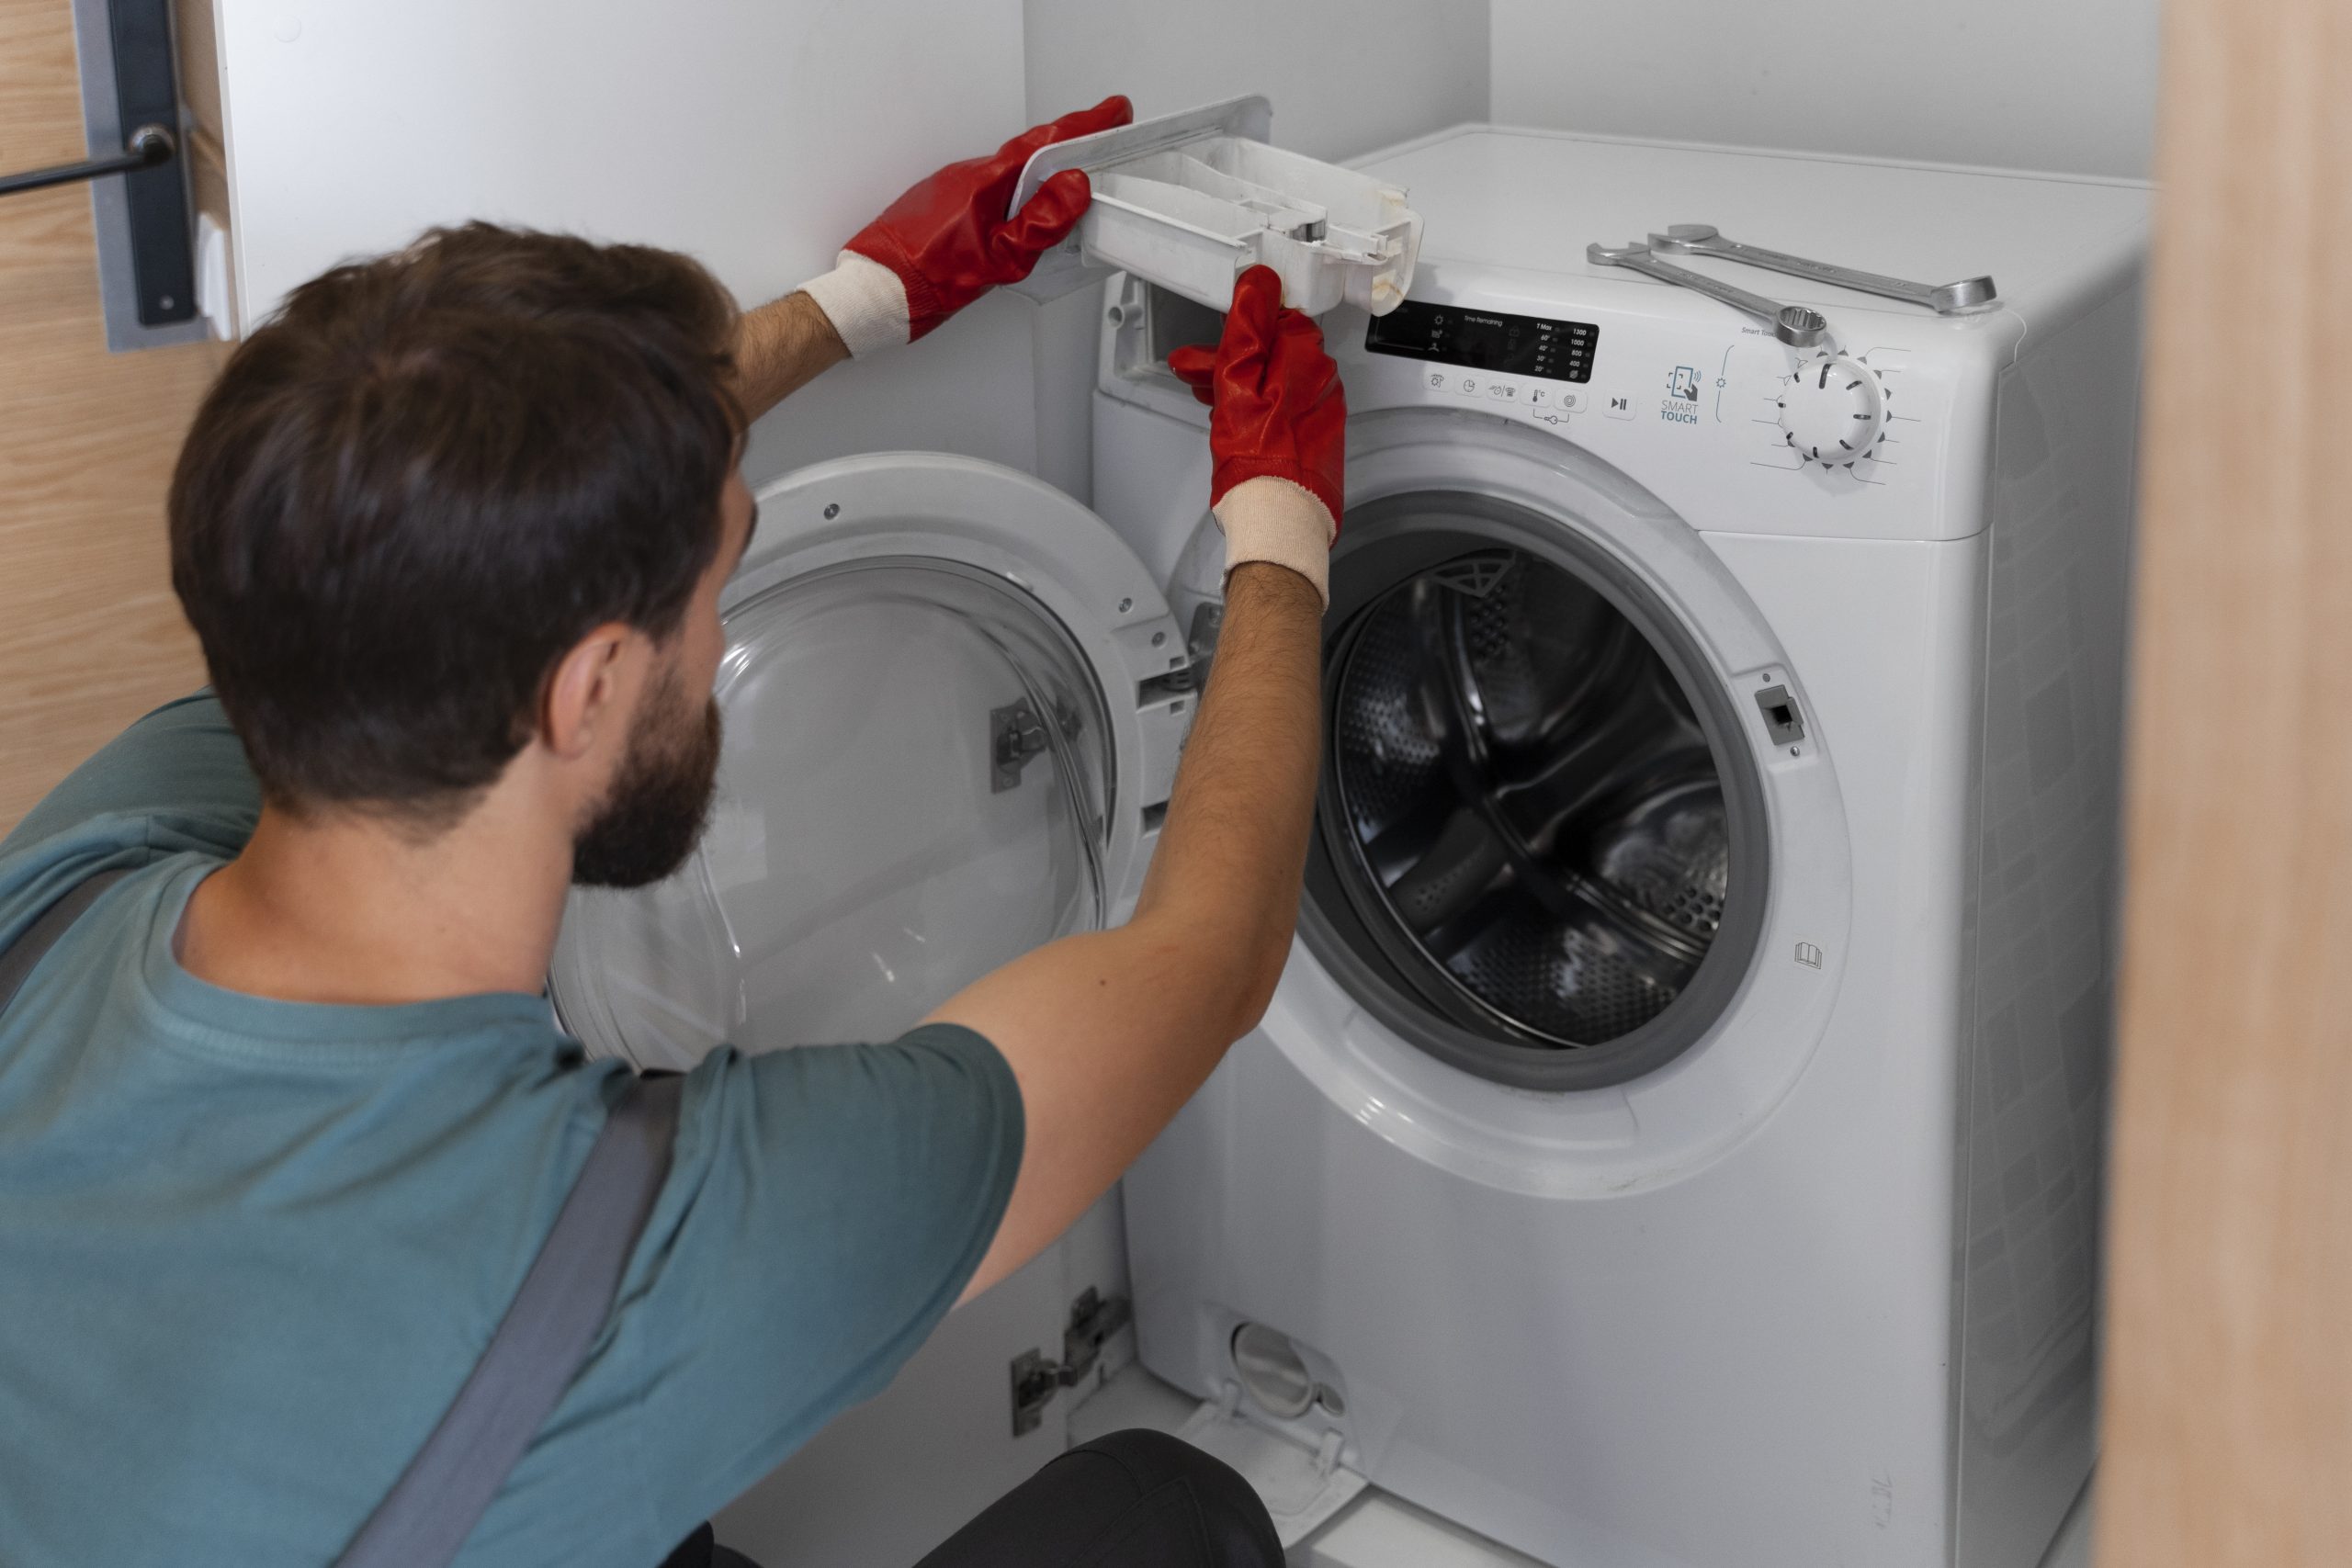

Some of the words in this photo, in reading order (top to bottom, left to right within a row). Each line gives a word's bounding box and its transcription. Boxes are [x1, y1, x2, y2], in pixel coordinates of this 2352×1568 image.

[1476, 317, 1503, 327] Remaining
[1573, 328, 1587, 336] 1300
[1741, 327, 1760, 335] Smart
[1571, 338, 1585, 346] 1000
[1661, 400, 1699, 414] SMART
[1661, 411, 1697, 424] TOUCH
